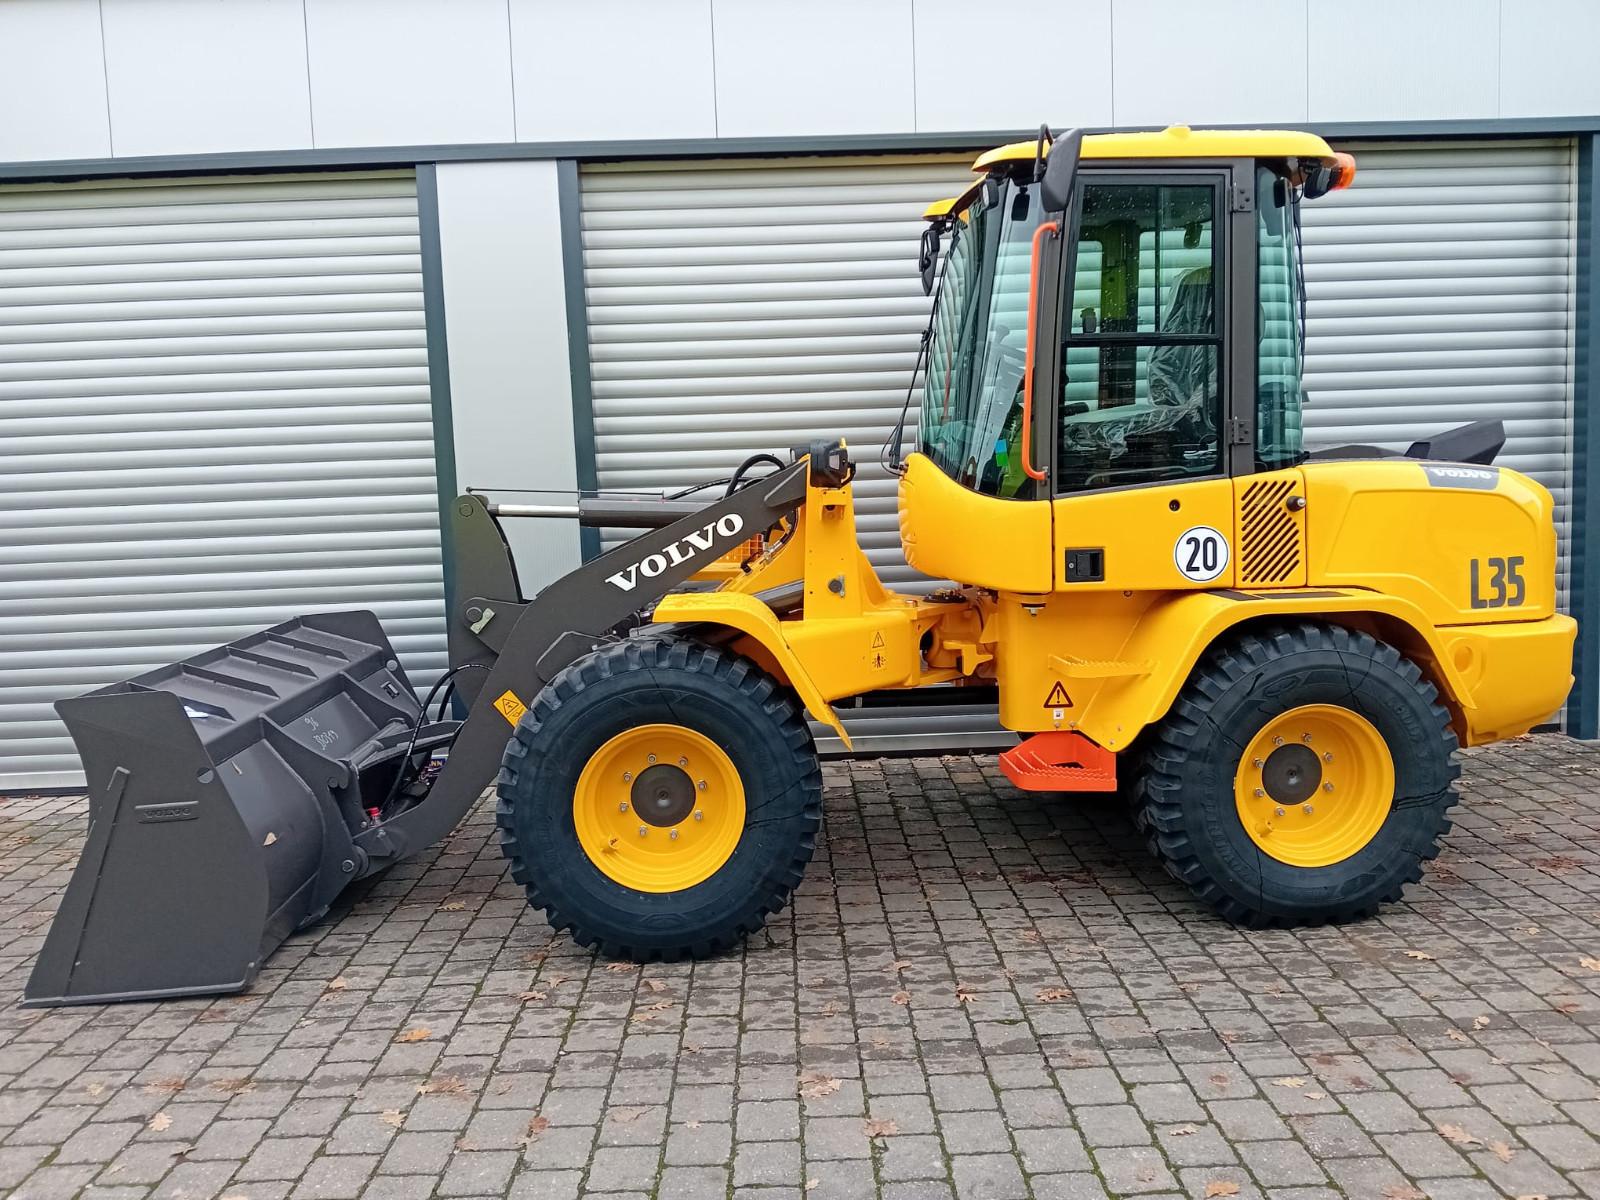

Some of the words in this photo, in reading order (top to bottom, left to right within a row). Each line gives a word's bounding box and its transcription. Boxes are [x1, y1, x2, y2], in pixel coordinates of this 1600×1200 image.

[1429, 467, 1493, 480] VOLVO
[604, 513, 744, 592] VOLVO
[1186, 536, 1218, 572] 20
[1470, 555, 1526, 610] L35
[143, 807, 192, 819] VOLVO
